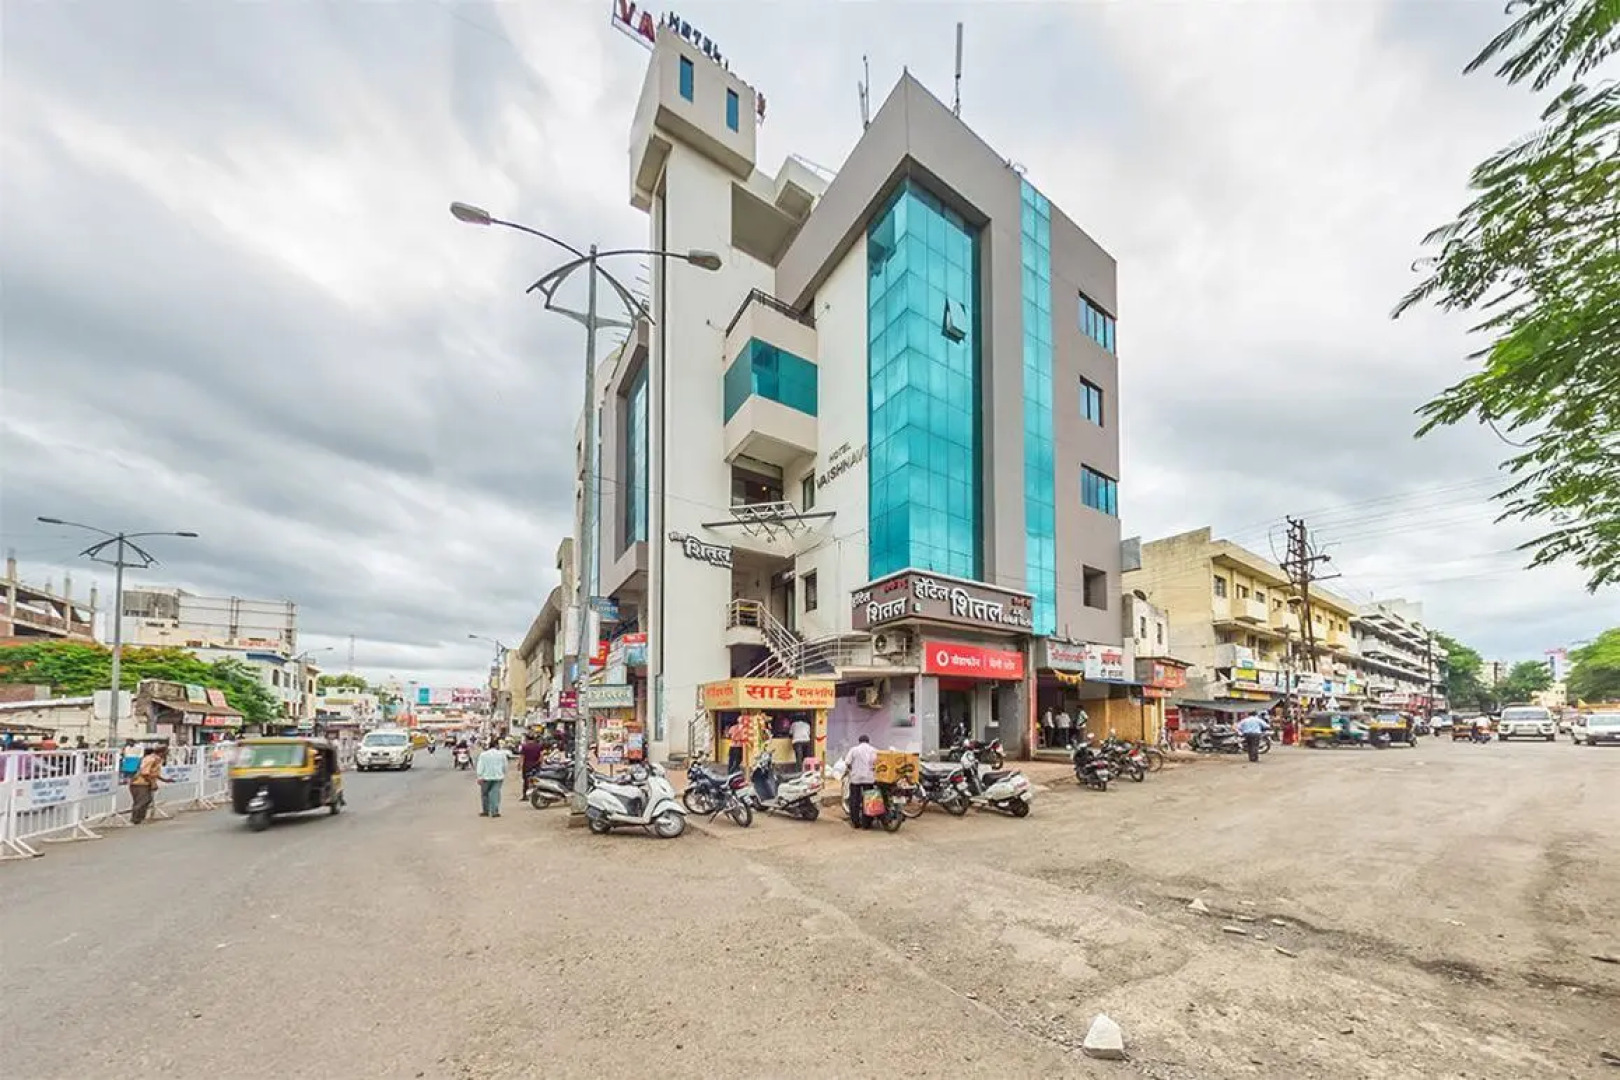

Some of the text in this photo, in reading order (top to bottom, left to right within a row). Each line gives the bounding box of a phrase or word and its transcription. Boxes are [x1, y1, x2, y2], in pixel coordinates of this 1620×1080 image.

[829, 441, 852, 464] HOTEL
[865, 596, 908, 625] शितल
[914, 577, 949, 602] हॉटेल
[950, 588, 1003, 623] शितल
[745, 680, 794, 701] साई
